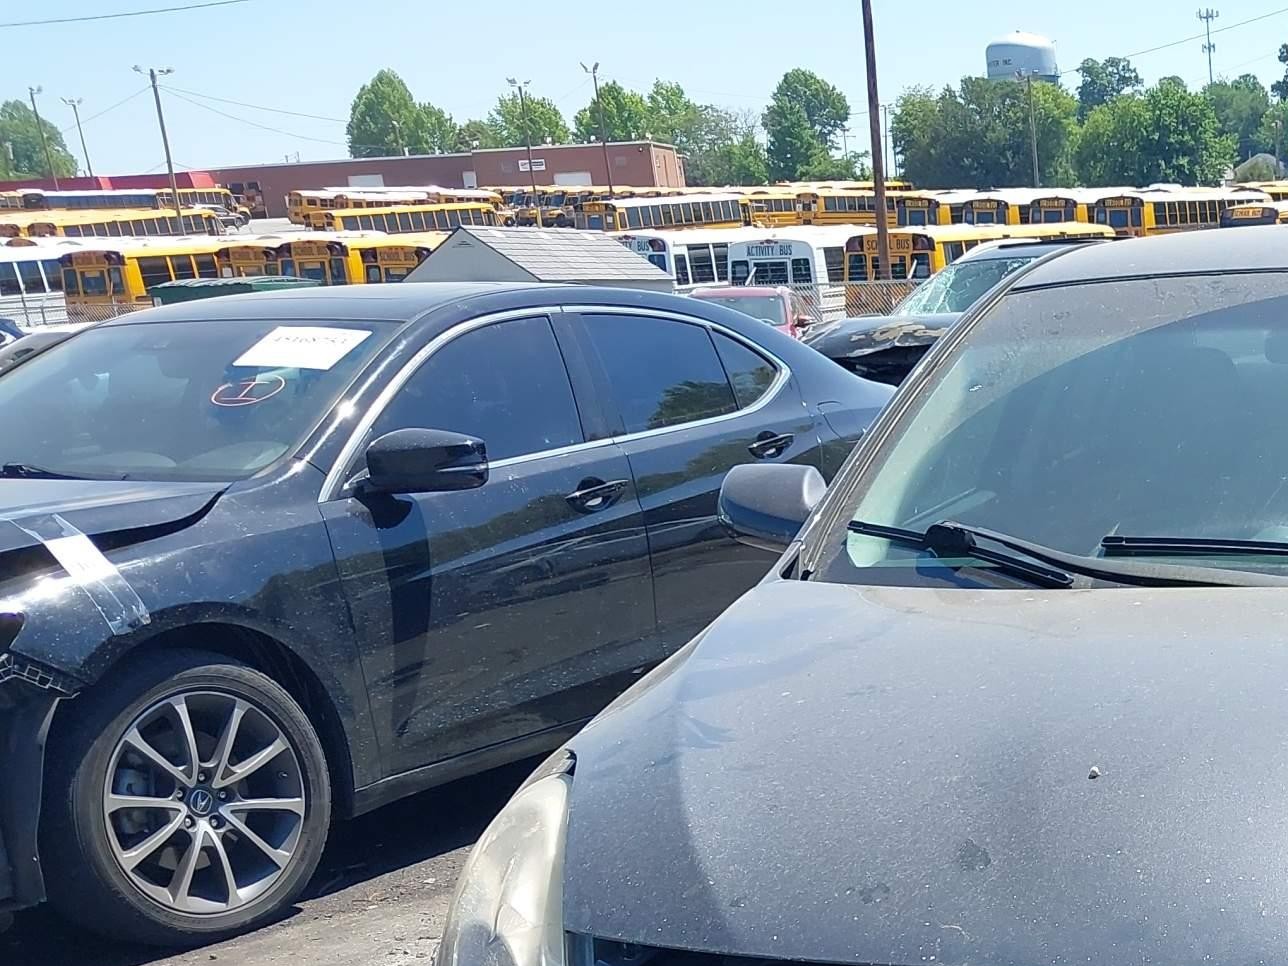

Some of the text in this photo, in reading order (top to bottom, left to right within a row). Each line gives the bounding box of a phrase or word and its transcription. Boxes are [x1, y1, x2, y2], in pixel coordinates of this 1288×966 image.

[637, 240, 650, 252] BUS
[896, 239, 910, 250] BUS
[746, 245, 793, 257] ACTIVITY BUS
